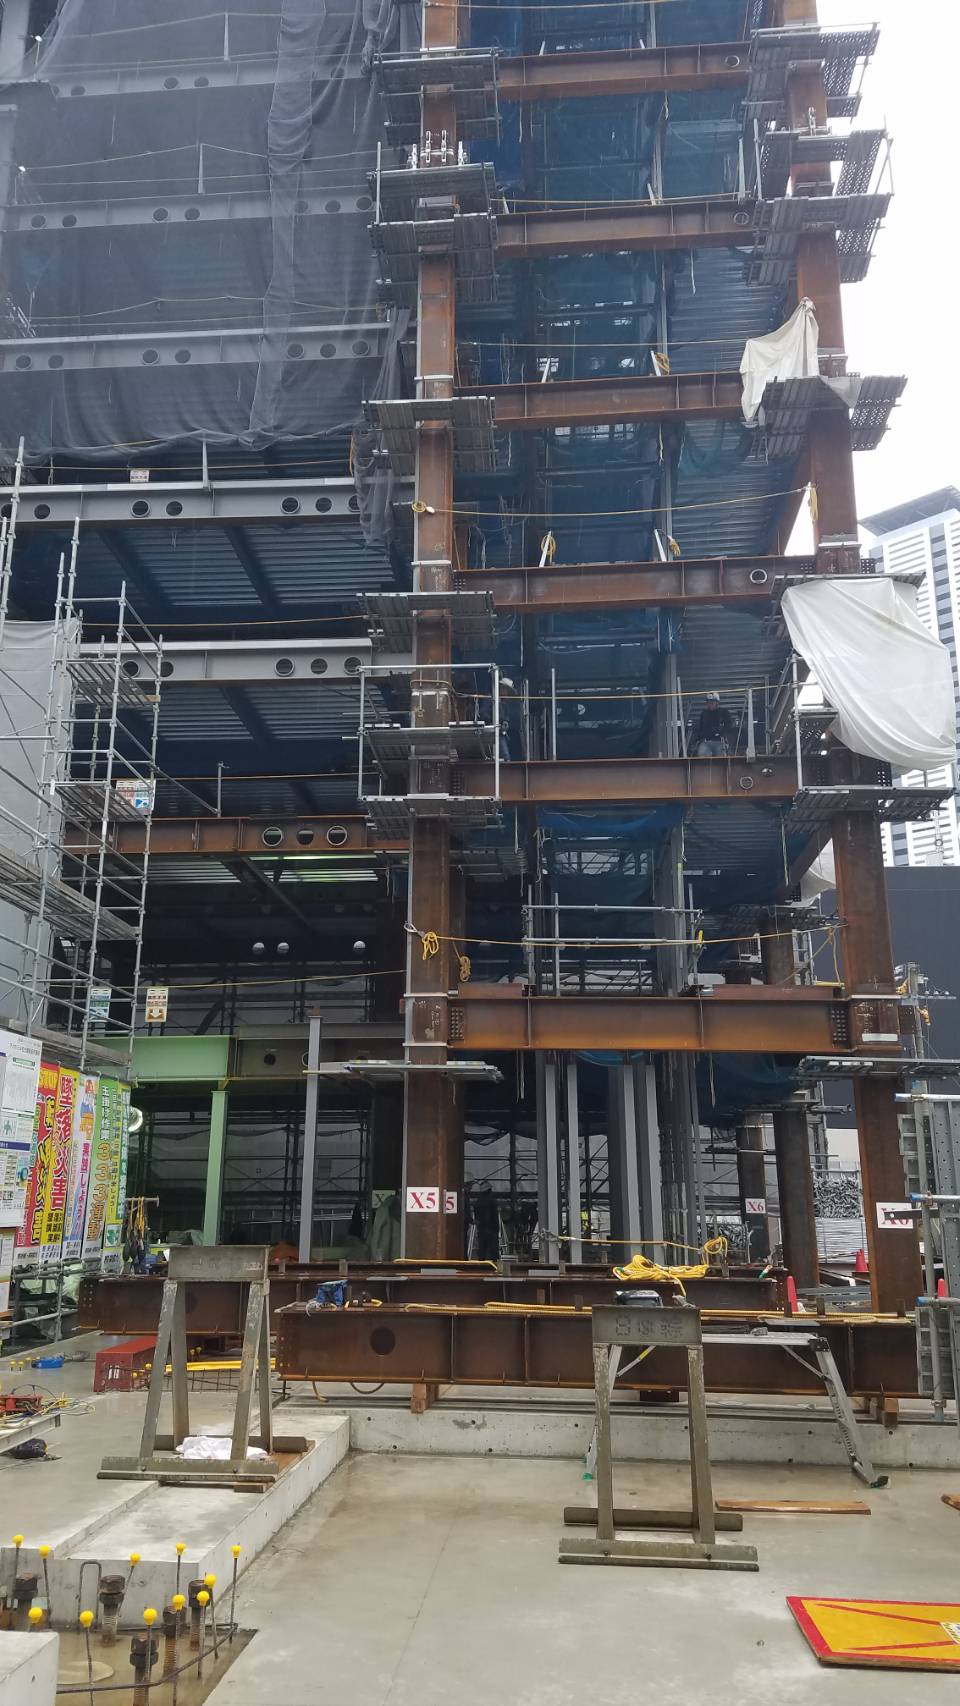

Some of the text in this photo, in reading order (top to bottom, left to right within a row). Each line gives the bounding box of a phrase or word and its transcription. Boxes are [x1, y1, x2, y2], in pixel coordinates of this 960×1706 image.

[50, 1075, 73, 1211] 墜落災害
[410, 1191, 436, 1209] X5
[747, 1201, 764, 1212] X6
